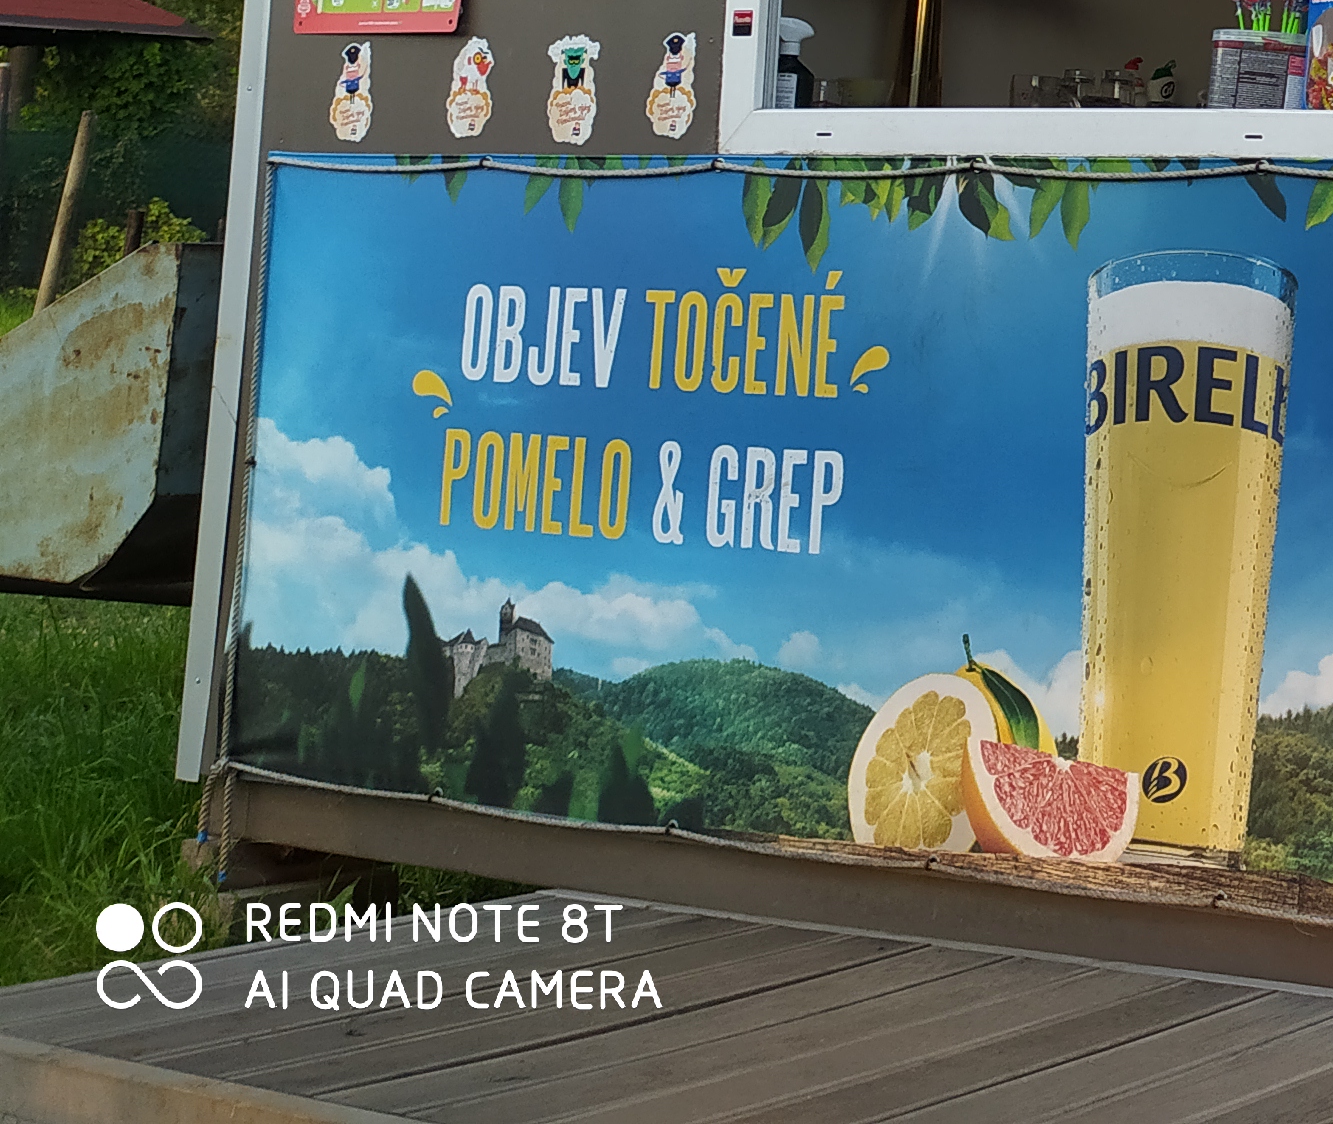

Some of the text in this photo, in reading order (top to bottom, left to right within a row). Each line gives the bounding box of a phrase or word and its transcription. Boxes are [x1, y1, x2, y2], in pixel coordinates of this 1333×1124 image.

[461, 267, 845, 398] OBJEV TOČENÉ
[440, 428, 844, 555] POMELO & GREP
